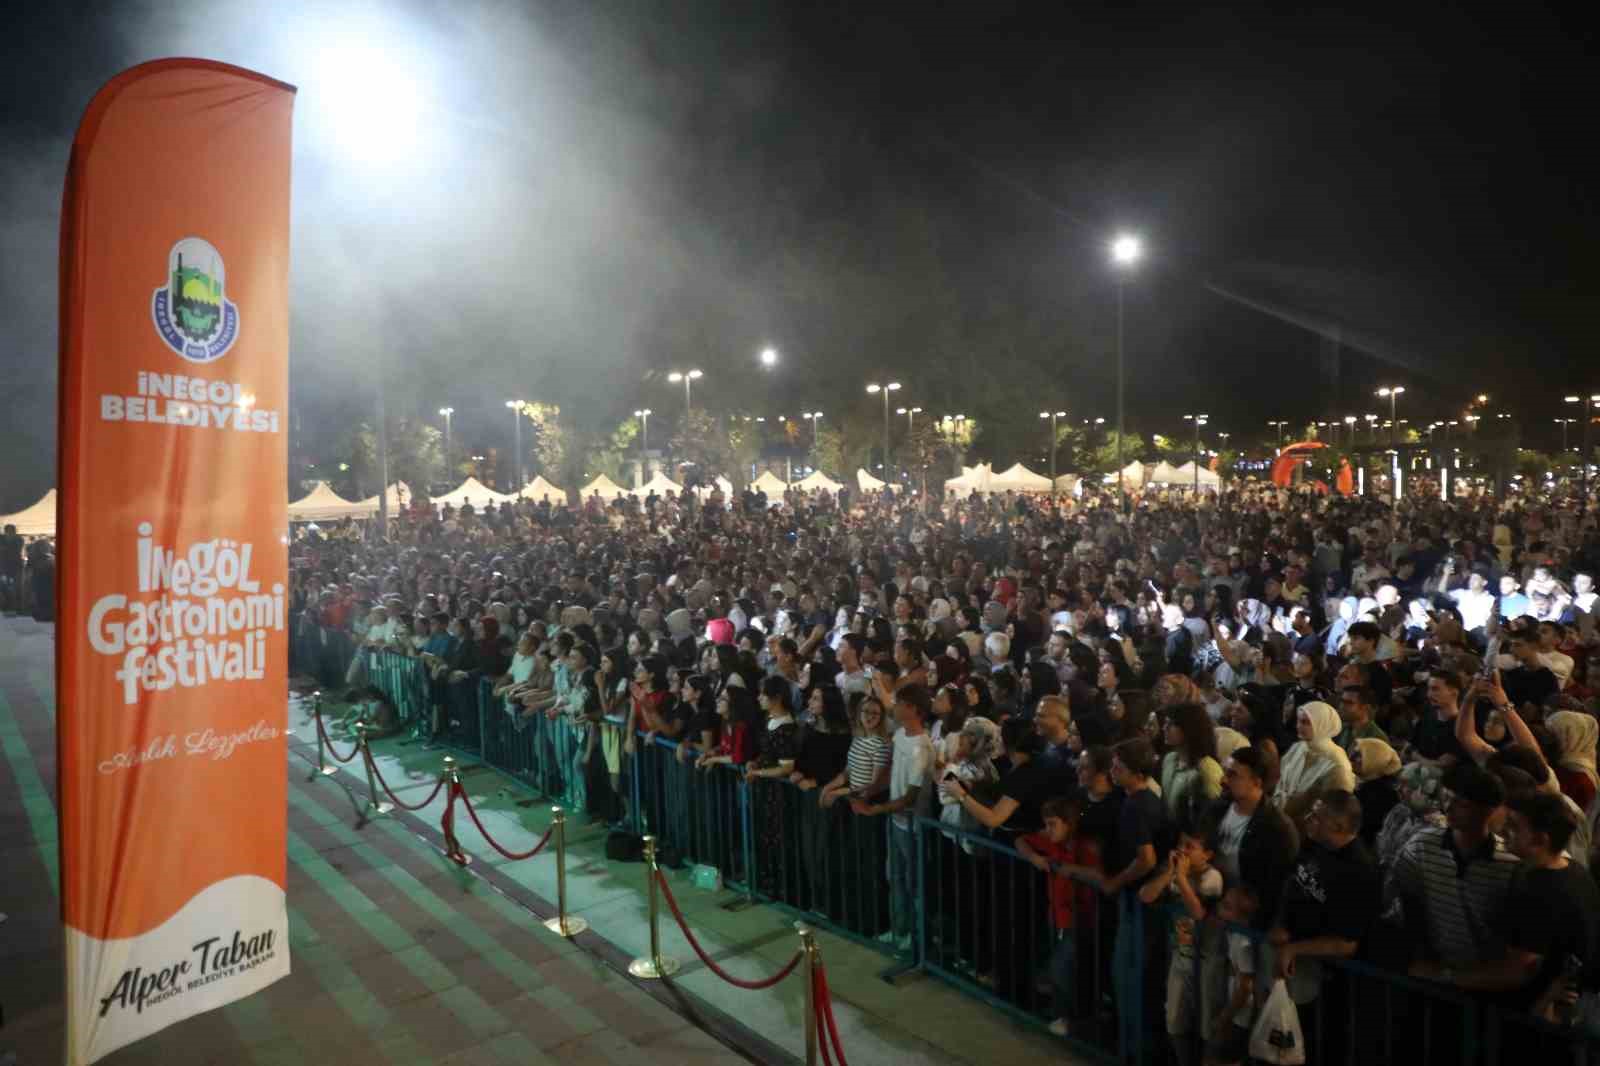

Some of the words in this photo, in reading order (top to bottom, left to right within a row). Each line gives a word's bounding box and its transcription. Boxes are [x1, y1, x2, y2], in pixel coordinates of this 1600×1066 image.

[88, 583, 284, 655] Gastronomi
[99, 961, 192, 1017] Alper
[192, 928, 276, 975] Taban
